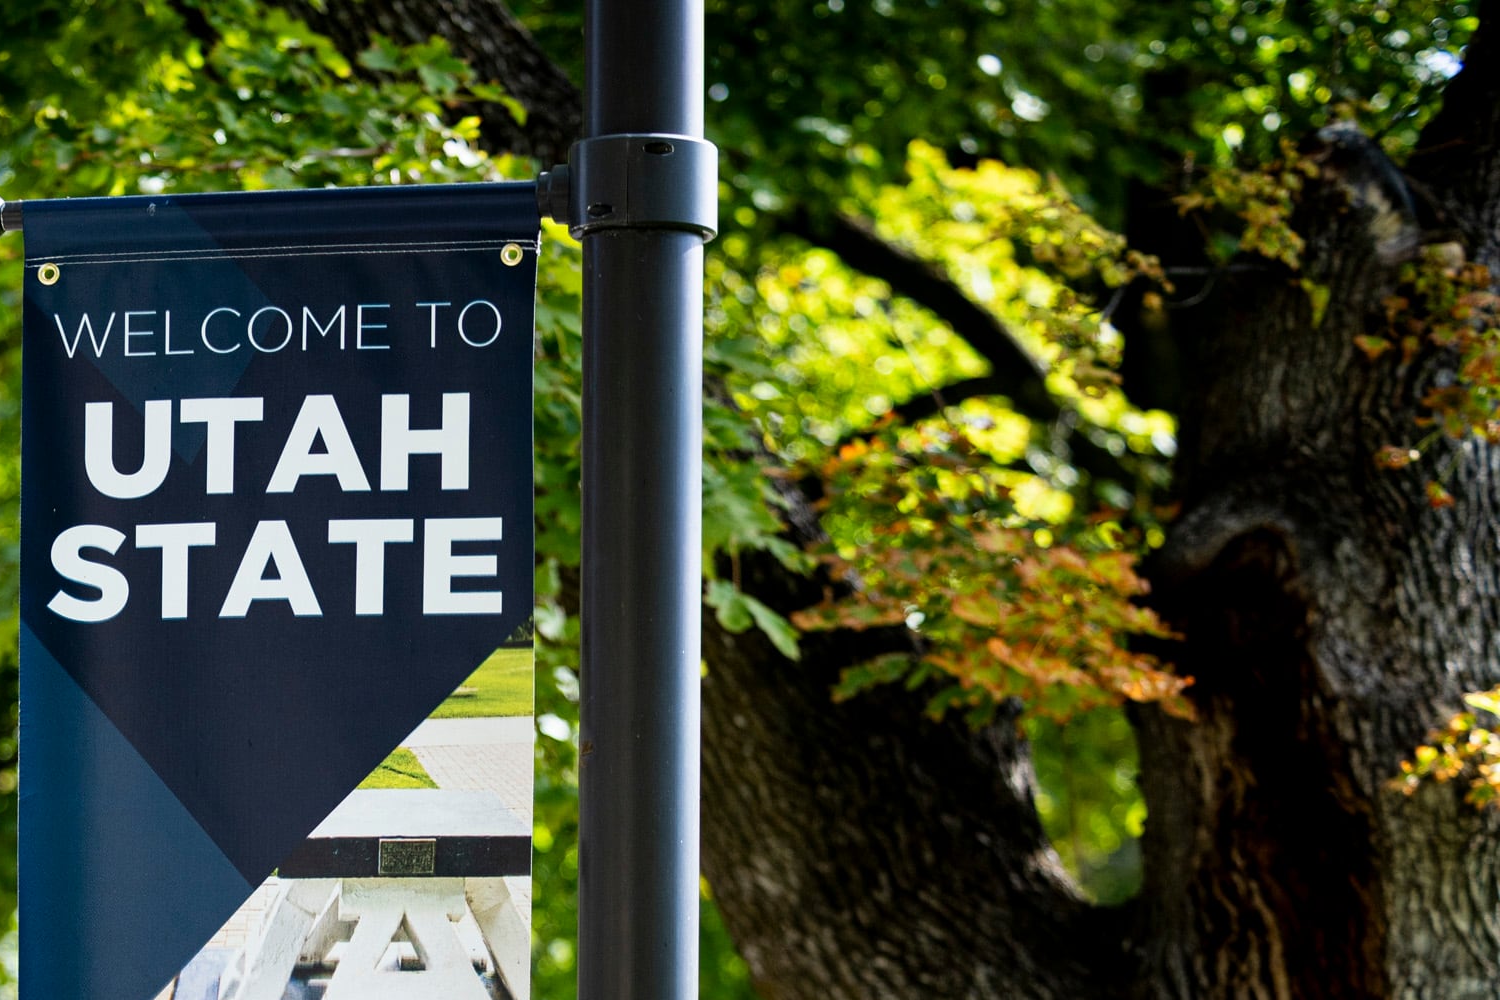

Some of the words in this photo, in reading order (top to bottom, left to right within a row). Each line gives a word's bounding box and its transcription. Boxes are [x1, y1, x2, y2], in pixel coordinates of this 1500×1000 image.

[54, 304, 391, 359] WELCOME
[415, 300, 502, 348] TO
[84, 392, 471, 499] UTAH
[47, 516, 503, 623] STATE
